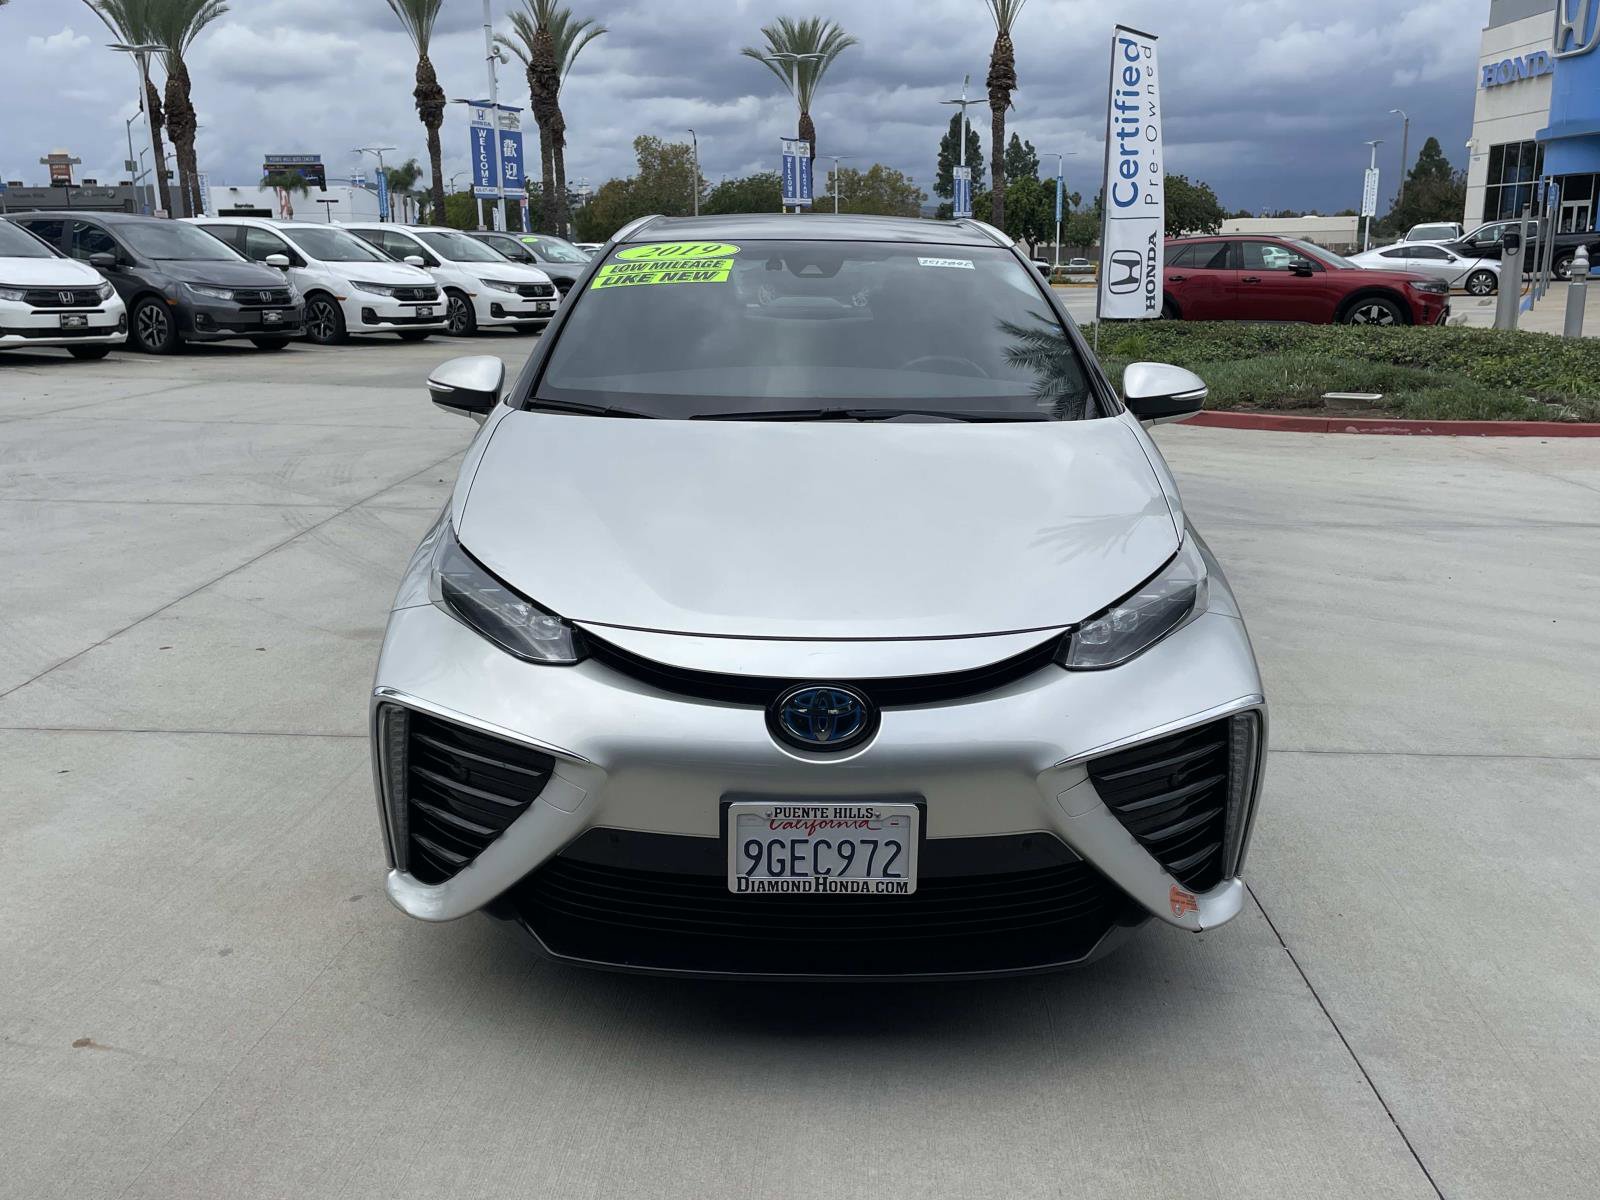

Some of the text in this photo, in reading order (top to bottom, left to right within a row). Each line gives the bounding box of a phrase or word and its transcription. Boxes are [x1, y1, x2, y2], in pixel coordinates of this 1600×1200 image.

[1481, 50, 1554, 88] HOND
[1113, 38, 1141, 208] Certified
[1140, 45, 1160, 205] Pre-Owned
[477, 128, 489, 186] WELCOME
[609, 260, 726, 274] LOW MILEAGE
[637, 244, 722, 258] 2019
[600, 271, 718, 287] LIKE NEW
[1145, 230, 1158, 312] HONDA
[769, 818, 882, 837] California
[773, 807, 874, 818] PUENTE HILLS
[743, 838, 902, 878] 9GEC972
